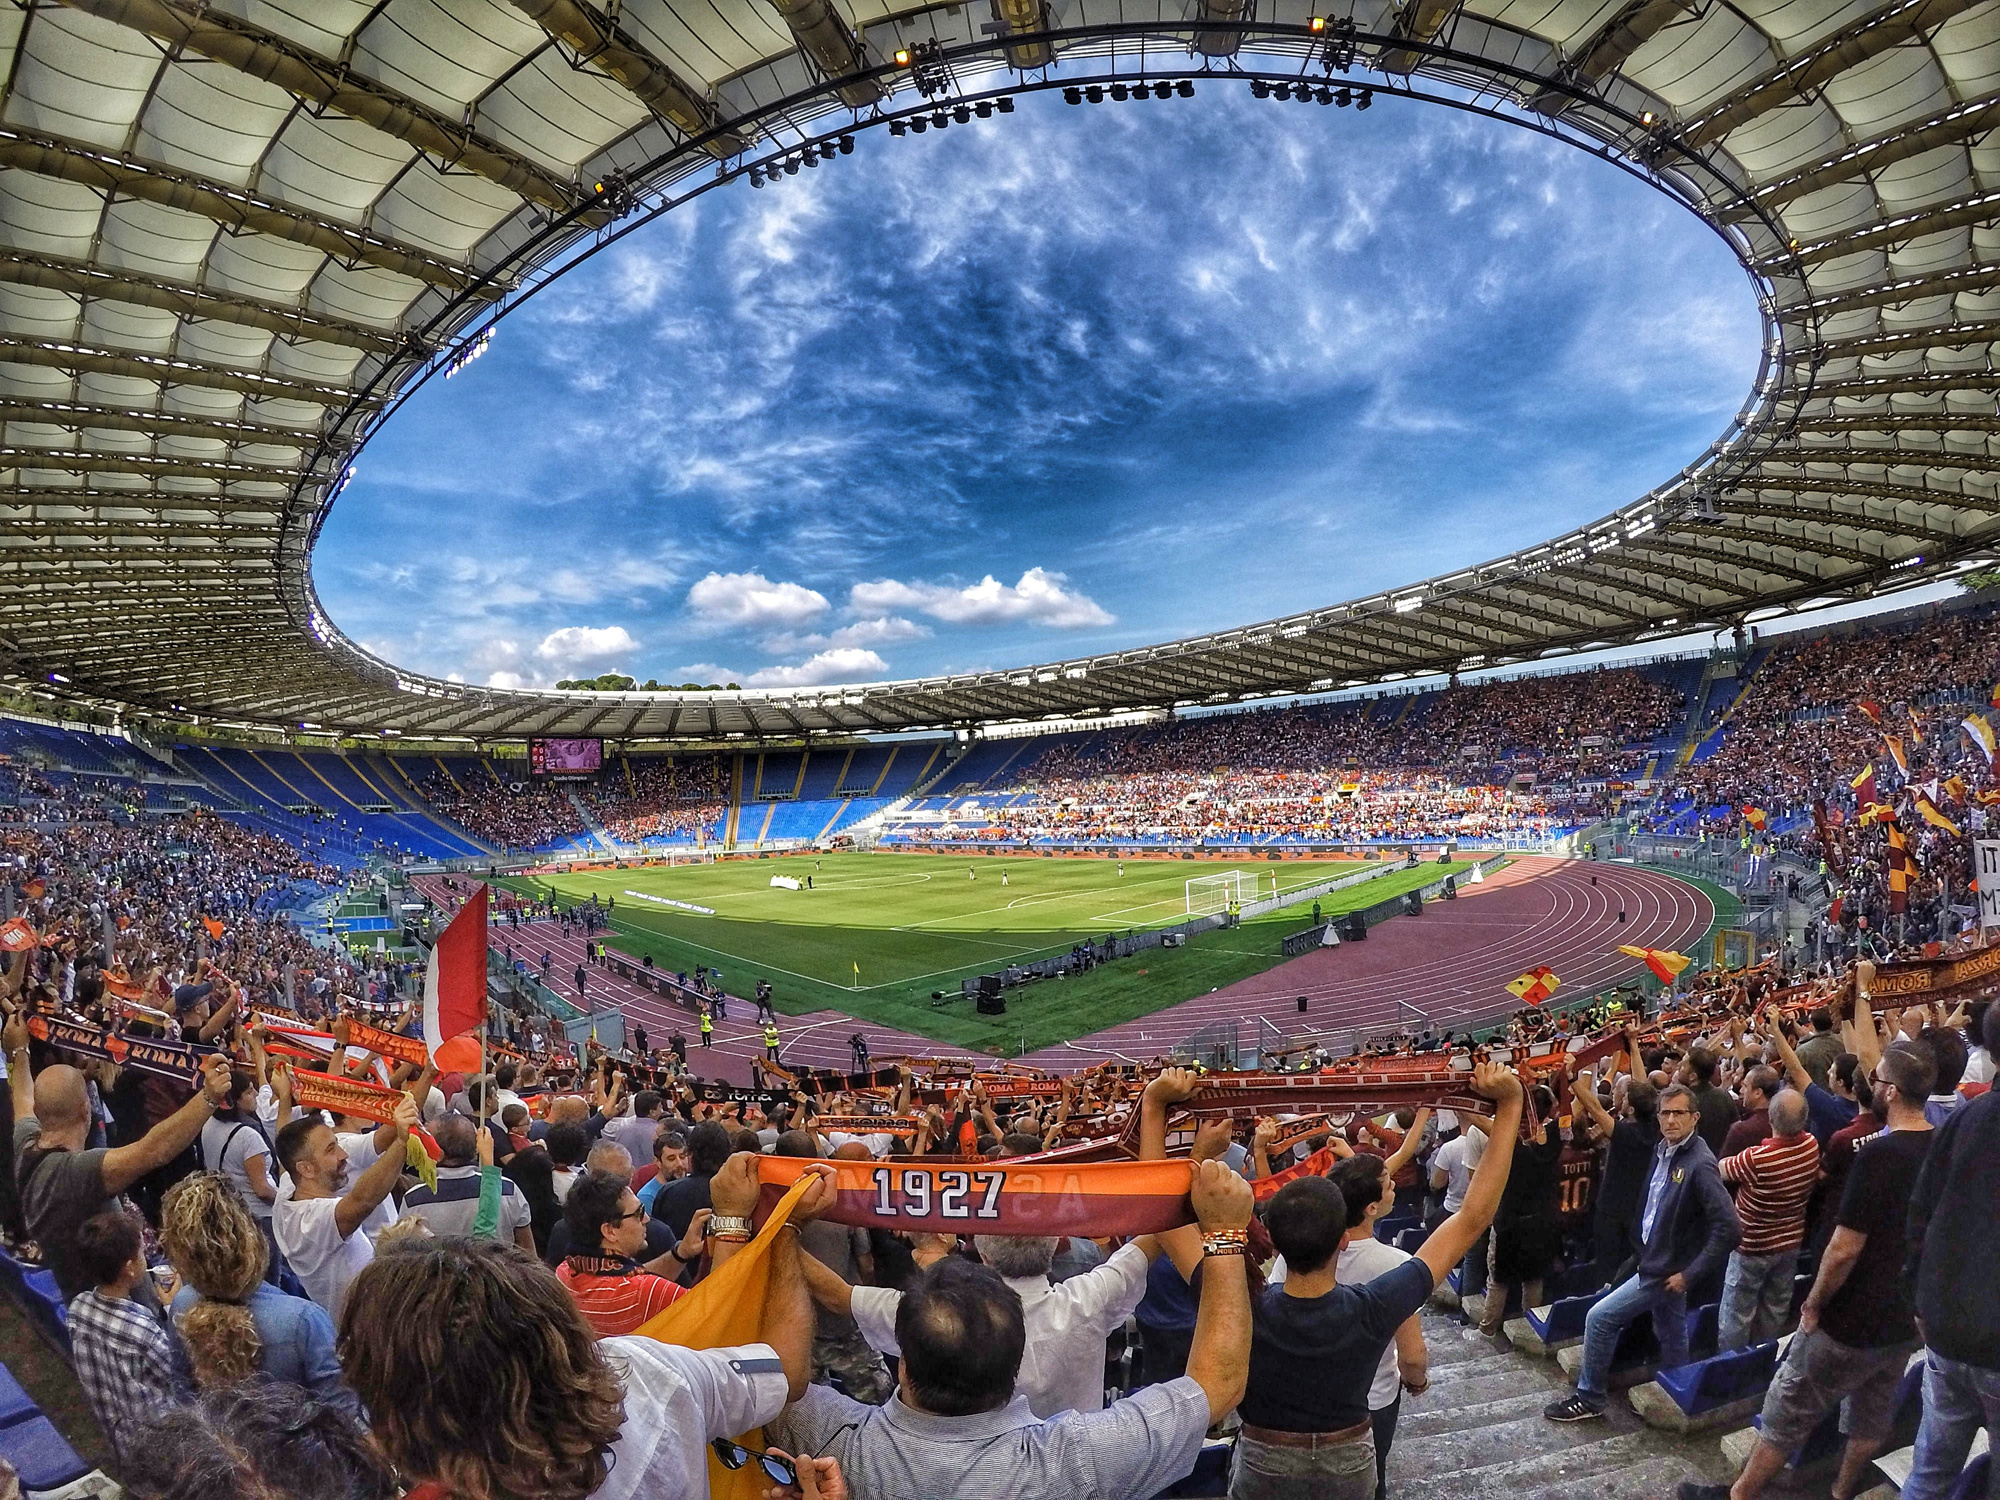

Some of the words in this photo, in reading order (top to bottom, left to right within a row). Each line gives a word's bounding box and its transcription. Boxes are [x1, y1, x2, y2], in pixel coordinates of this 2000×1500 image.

[56, 1026, 102, 1048] ROMA
[131, 1044, 188, 1068] ROMA
[728, 1089, 773, 1102] roma
[1031, 1082, 1061, 1092] ROMA
[1087, 1110, 1131, 1129] TO
[874, 1168, 1006, 1218] 1927
[1560, 1177, 1591, 1212] 10
